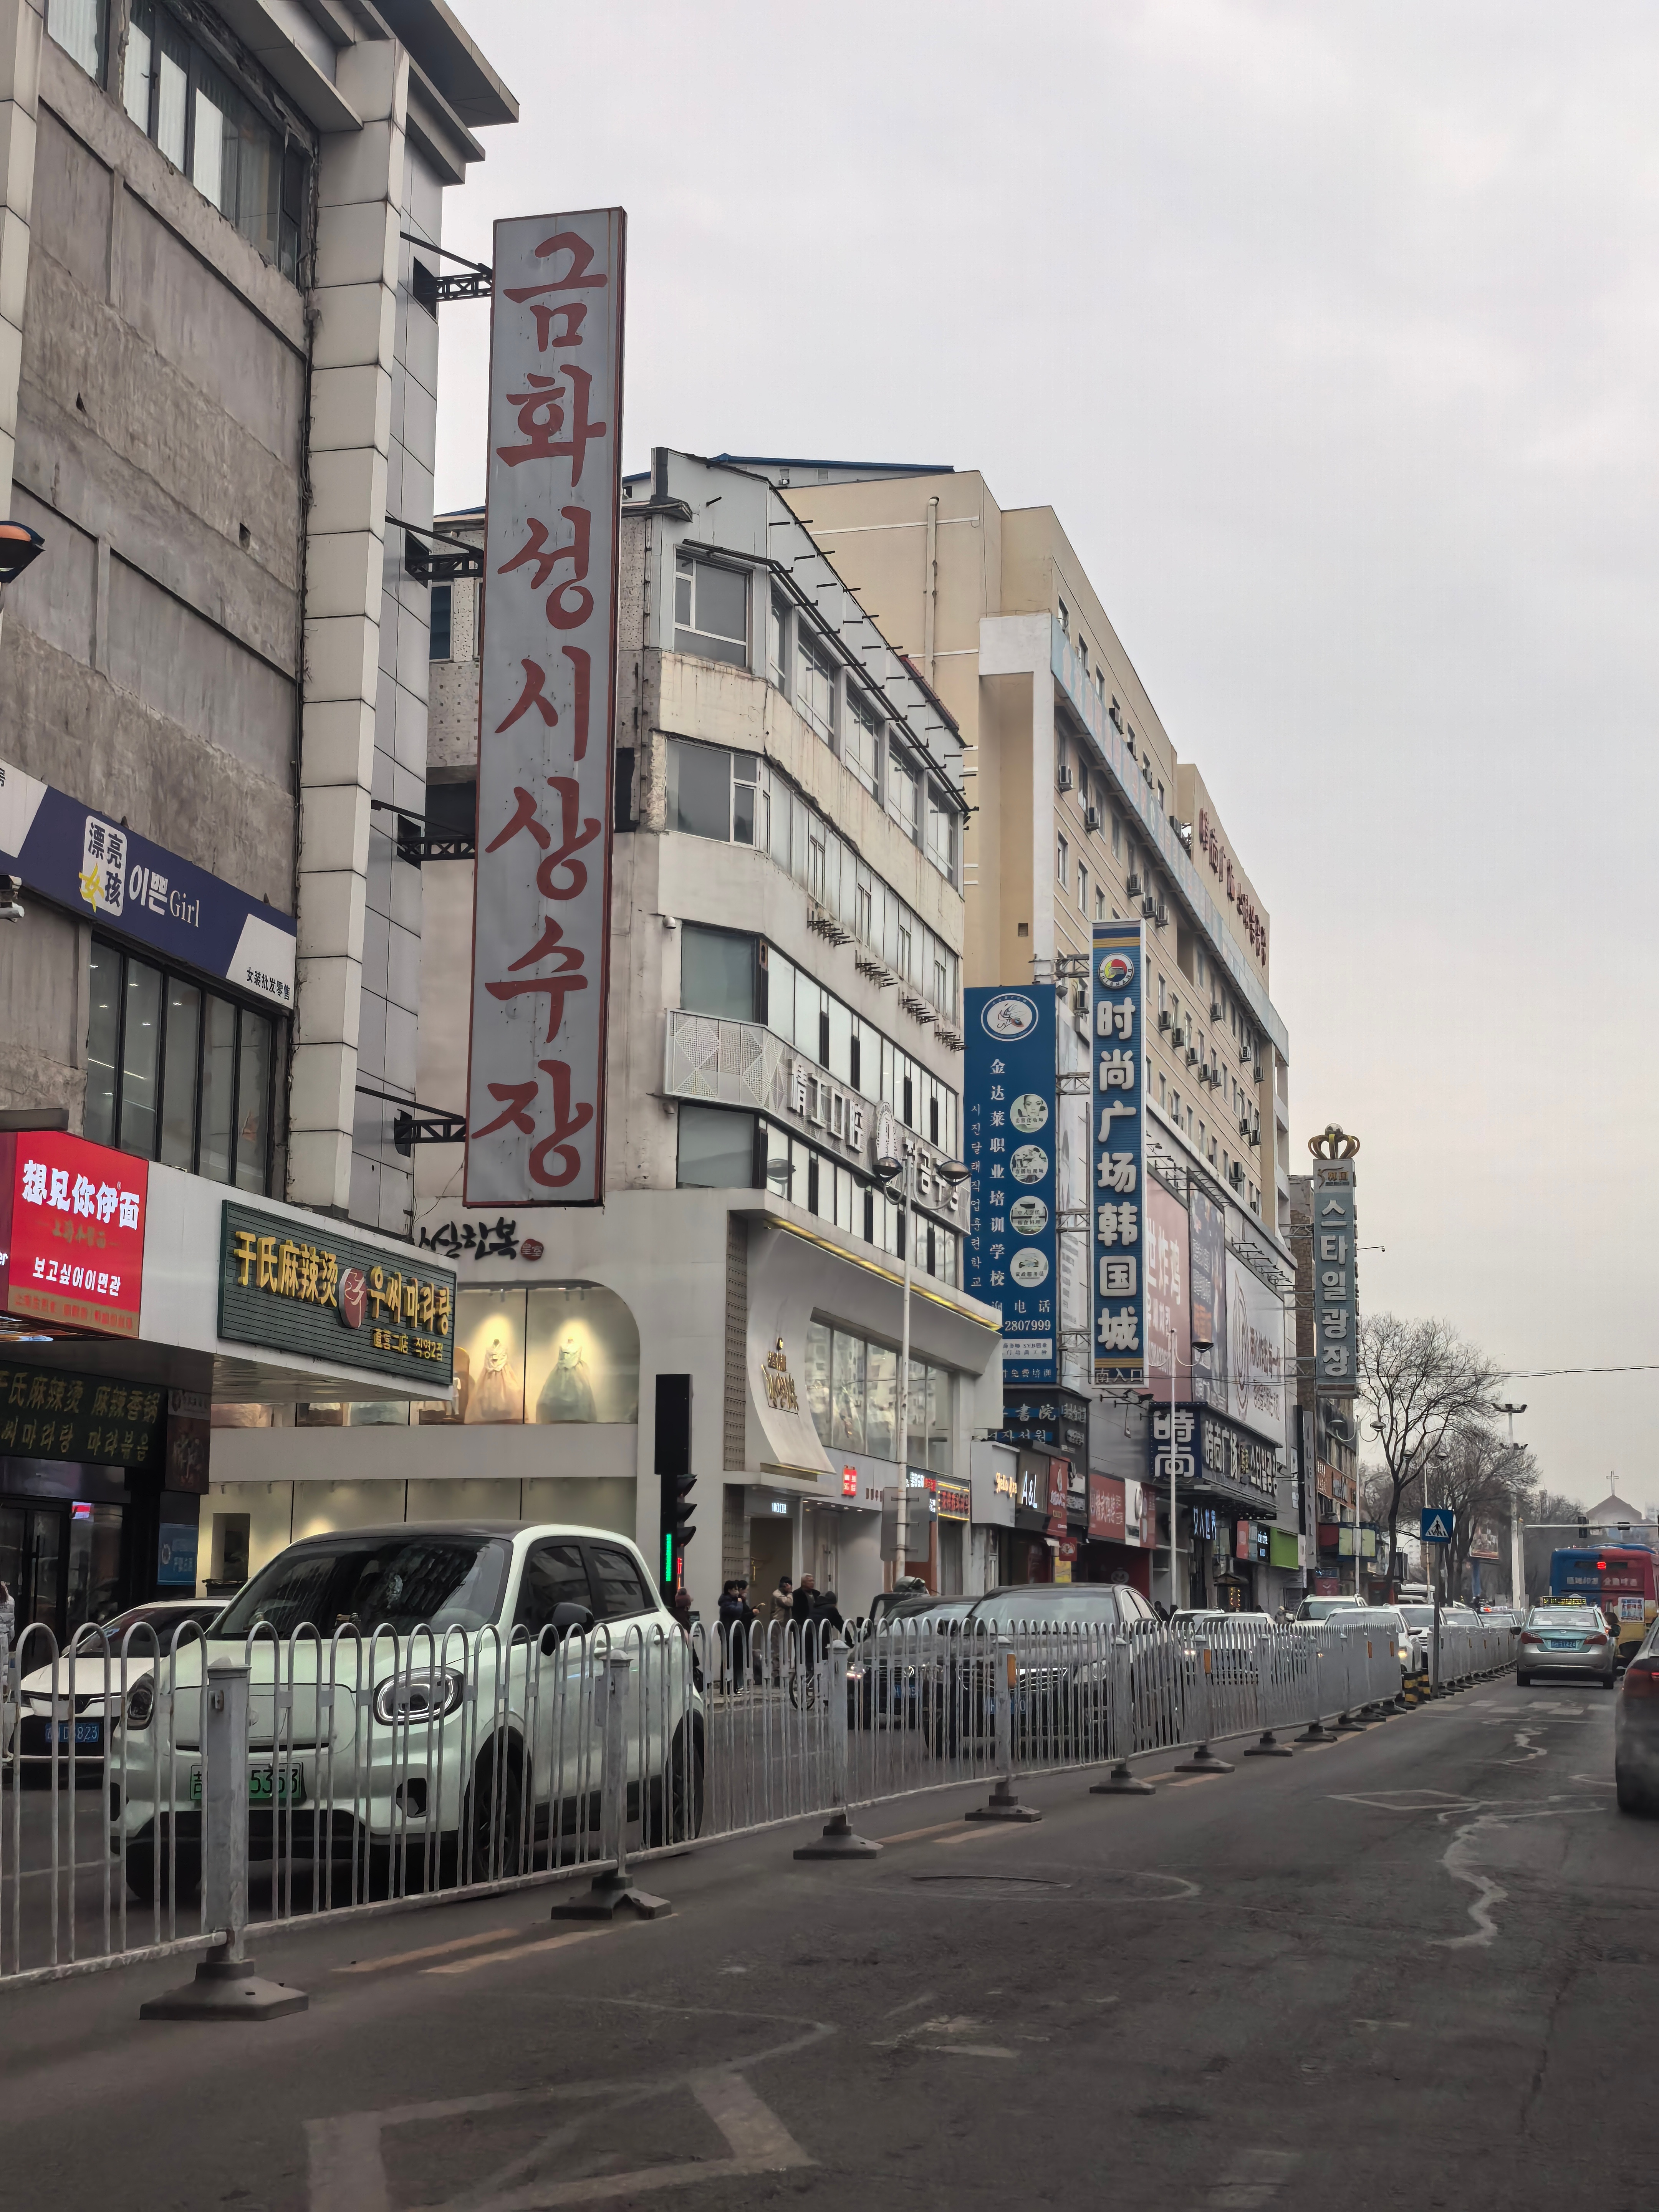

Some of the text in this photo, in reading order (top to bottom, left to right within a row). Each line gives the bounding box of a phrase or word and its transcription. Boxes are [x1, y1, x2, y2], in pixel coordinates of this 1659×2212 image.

[471, 231, 608, 1187] 금화성시상수장
[129, 864, 199, 928] 이쁜 Girl
[247, 967, 290, 1000] 女装批发零售
[22, 1160, 140, 1230] 想见你伊面
[902, 1137, 959, 1211] 공구
[990, 1059, 1005, 1286] 金达莱职业培训学校
[1097, 997, 1139, 1350] 时尚广场韩国城
[33, 1257, 121, 1296] 보고싶어이면관
[234, 1231, 338, 1307] 于氏麻辣烫
[367, 1266, 451, 1335] 우씨마라탕
[1320, 1200, 1349, 1377] 스타일광장
[1005, 1320, 1051, 1331] 2807999
[1095, 1368, 1143, 1383] 南入口
[1003, 1403, 1056, 1421] 書院
[1154, 1409, 1195, 1477] 時尚
[996, 1472, 1008, 1493] Hello
[1022, 1471, 1038, 1508] A&L
[46, 1726, 98, 1739] D823
